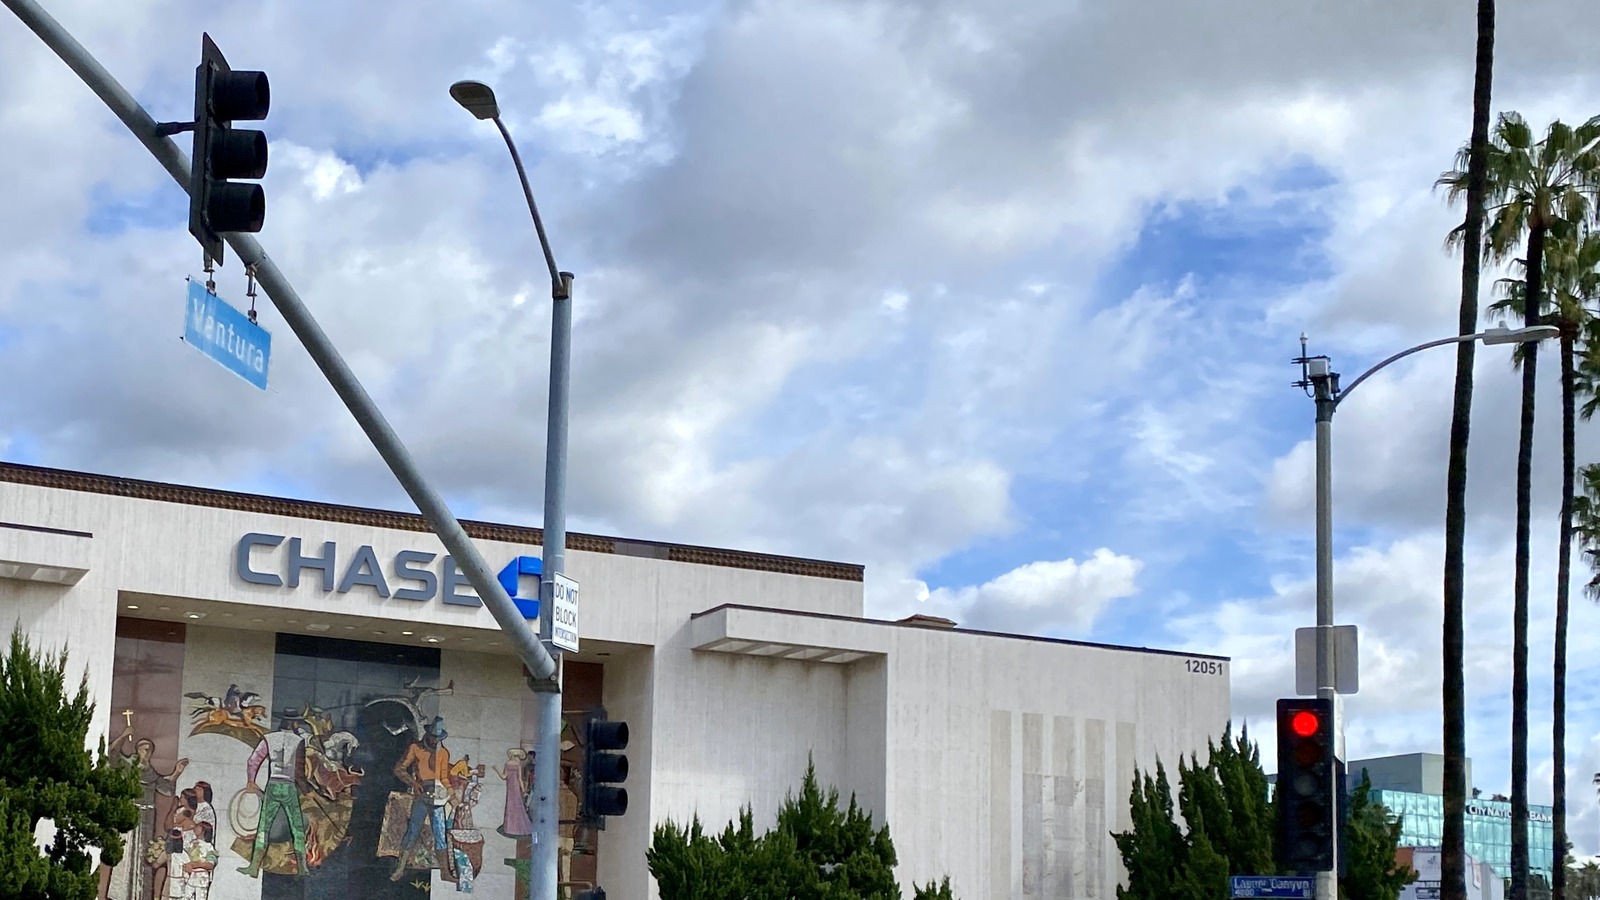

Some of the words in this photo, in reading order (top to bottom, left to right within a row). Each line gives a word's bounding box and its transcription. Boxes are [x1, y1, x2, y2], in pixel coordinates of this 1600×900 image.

[193, 297, 264, 373] Ventura
[237, 532, 484, 607] CHASE
[555, 582, 565, 600] DO
[566, 586, 578, 605] NOT
[555, 606, 577, 628] BLOCK
[1185, 659, 1223, 676] 12051
[1469, 805, 1487, 815] CITY
[1487, 806, 1512, 819] NATIO
[1529, 811, 1553, 823] BANK
